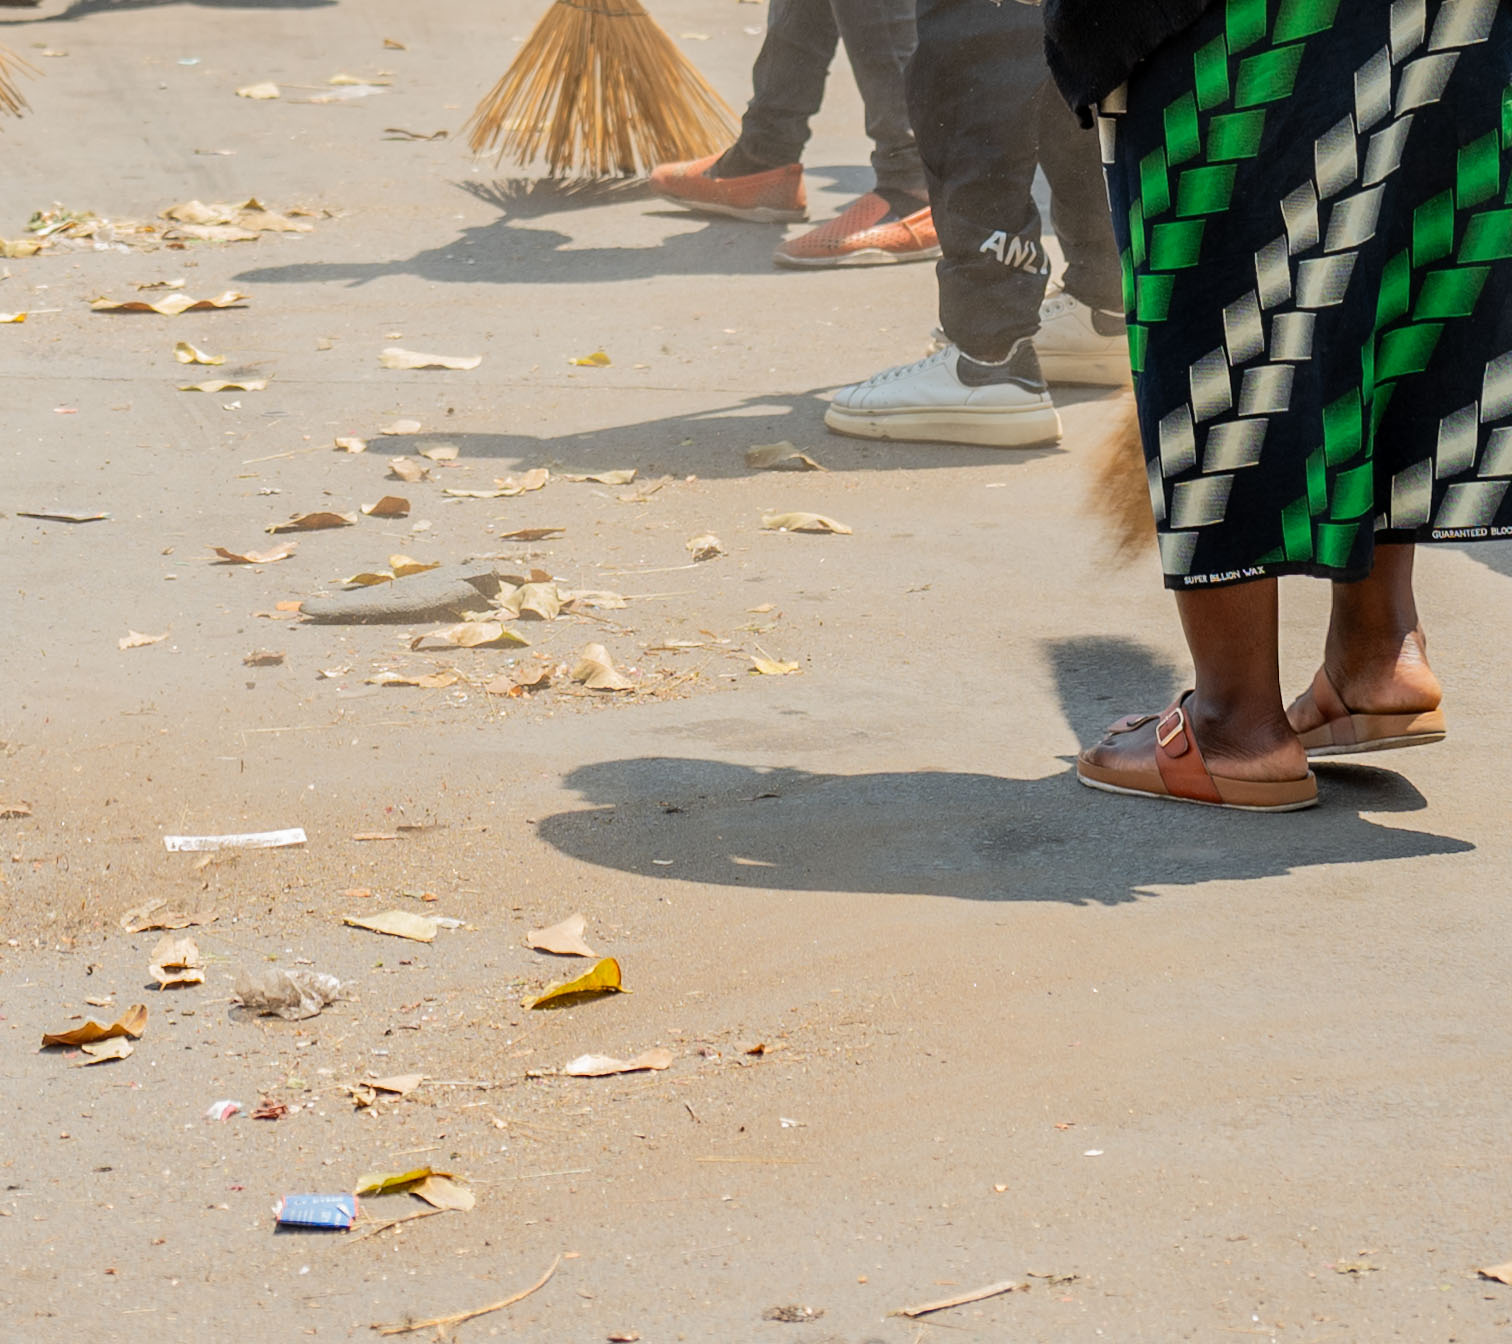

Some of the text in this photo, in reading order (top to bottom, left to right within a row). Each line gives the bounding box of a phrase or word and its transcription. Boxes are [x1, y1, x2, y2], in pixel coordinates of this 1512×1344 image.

[1432, 527, 1488, 539] GUARANTEED
[1184, 566, 1266, 585] SUPER BILLION WAX
